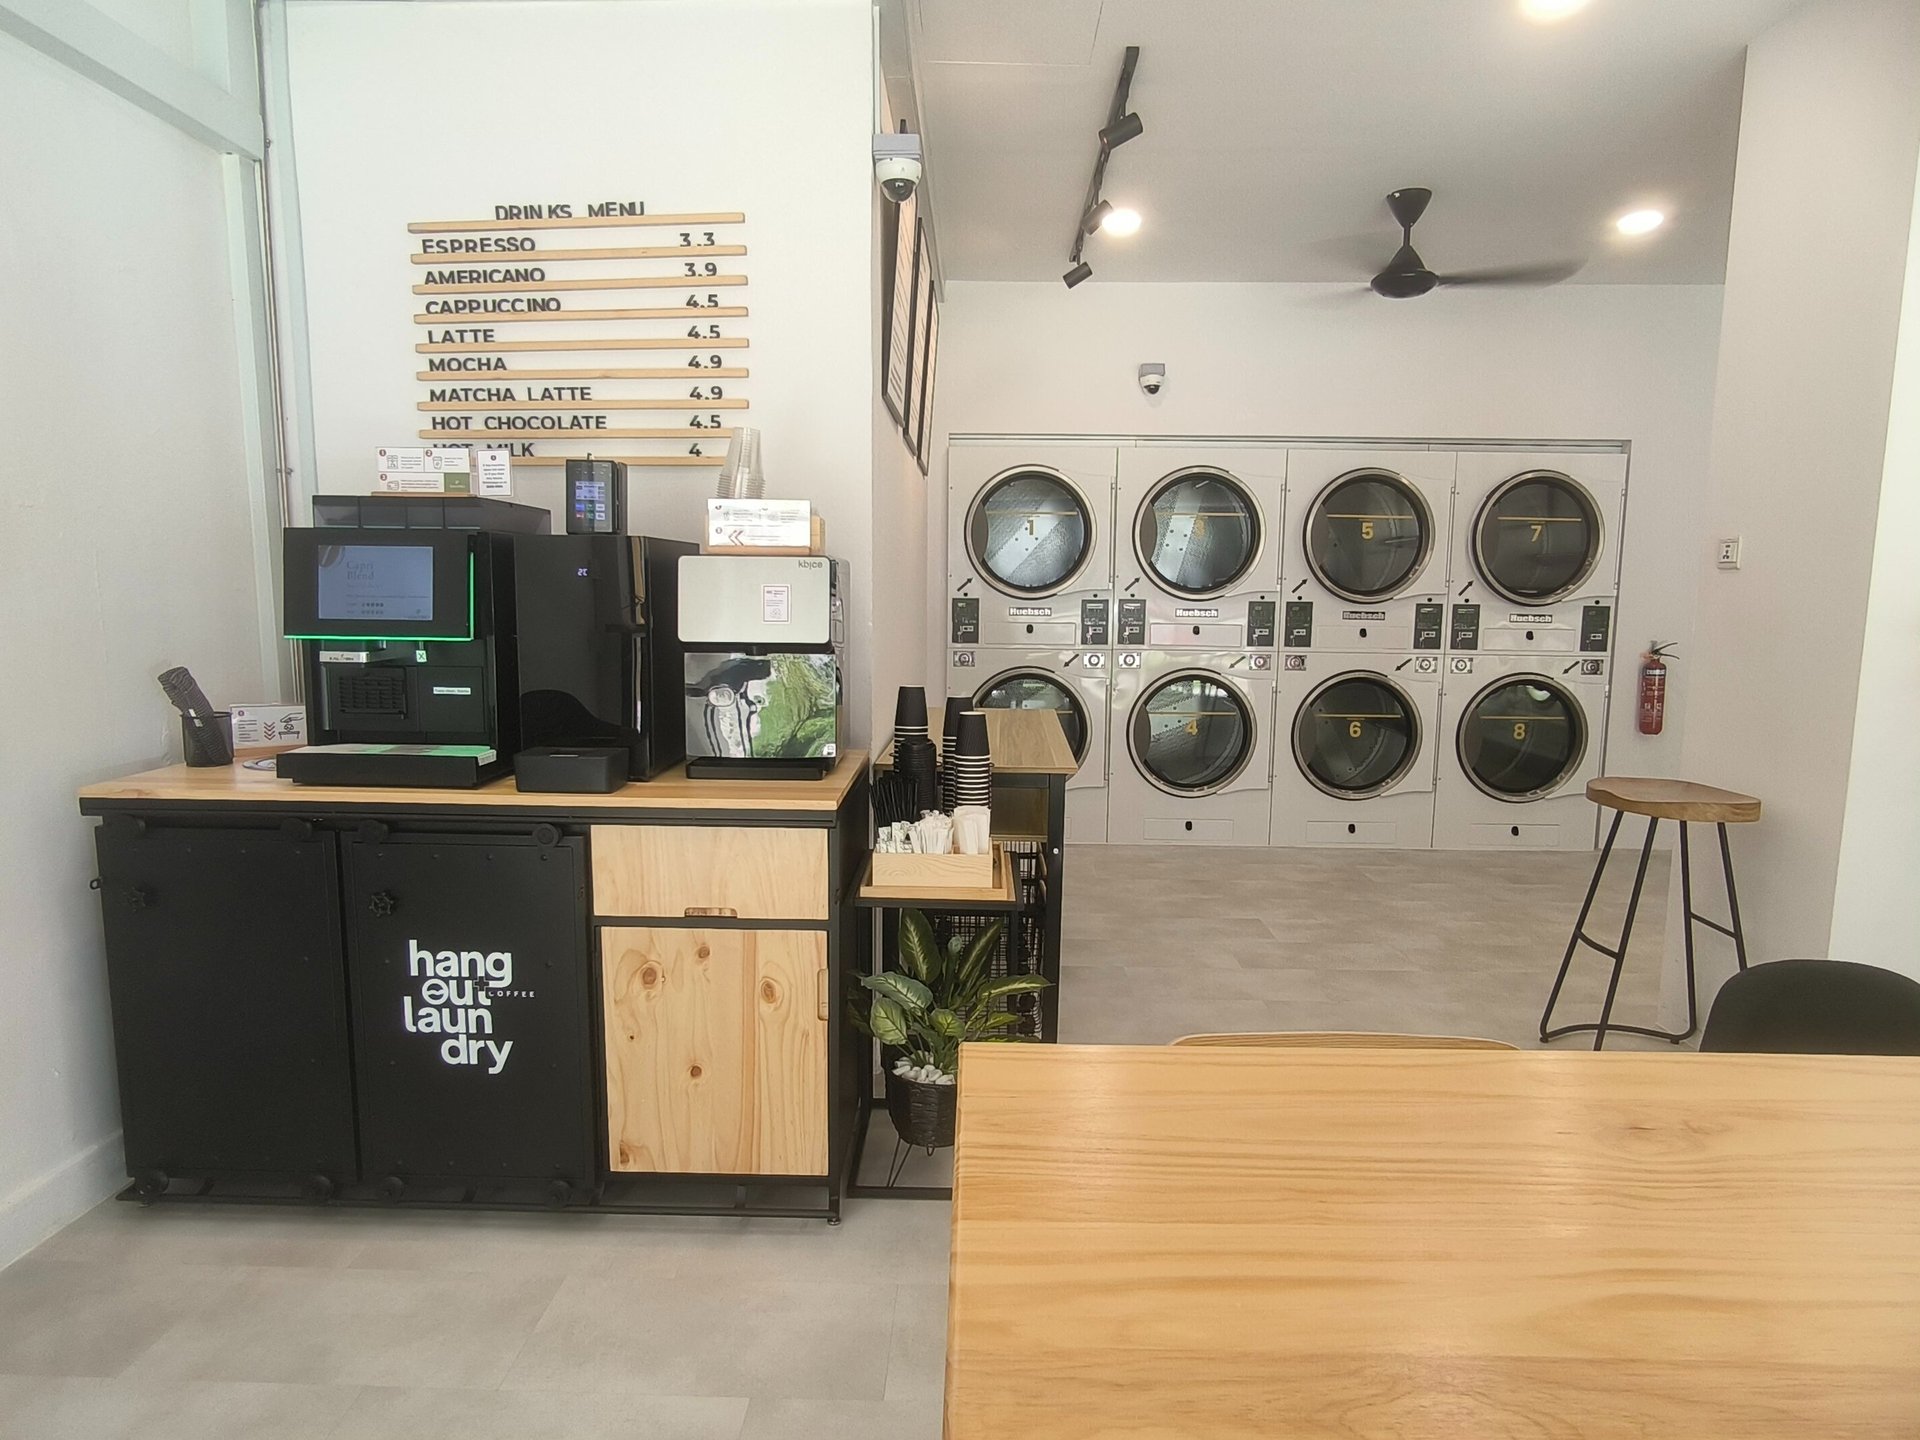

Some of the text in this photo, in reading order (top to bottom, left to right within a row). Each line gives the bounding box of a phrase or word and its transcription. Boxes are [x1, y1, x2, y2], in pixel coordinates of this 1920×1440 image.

[495, 201, 645, 220] DRINKS MENU
[421, 237, 536, 254] ESPRESSO
[679, 232, 715, 247] 3.3
[424, 268, 546, 285] AMERICANO
[684, 262, 717, 277] 3.9
[425, 297, 561, 315] CAPPUCCINO
[686, 294, 719, 309] 4.5
[427, 328, 495, 344] LATTE
[687, 324, 721, 339] 4.5
[428, 357, 508, 372] MOCHA
[688, 354, 722, 369] 4.9
[429, 386, 592, 402] MATCHA LATTE
[689, 385, 723, 400] 4.9
[431, 415, 607, 431] HOT CHOCOLATE
[689, 414, 722, 429] 4.5
[688, 443, 702, 457] 4
[1026, 519, 1034, 536] 1
[1361, 522, 1374, 540] 5
[1531, 525, 1542, 542] 7
[1010, 607, 1051, 616] Huebsch
[1176, 609, 1218, 617] Huebsch
[1510, 614, 1552, 622] Huebsch
[1186, 719, 1198, 735] 4
[1348, 721, 1361, 738] 6
[1513, 723, 1526, 740] 8
[409, 939, 512, 988] hang
[422, 978, 492, 1006] out
[403, 996, 493, 1034] laun
[440, 1033, 514, 1075] dry
